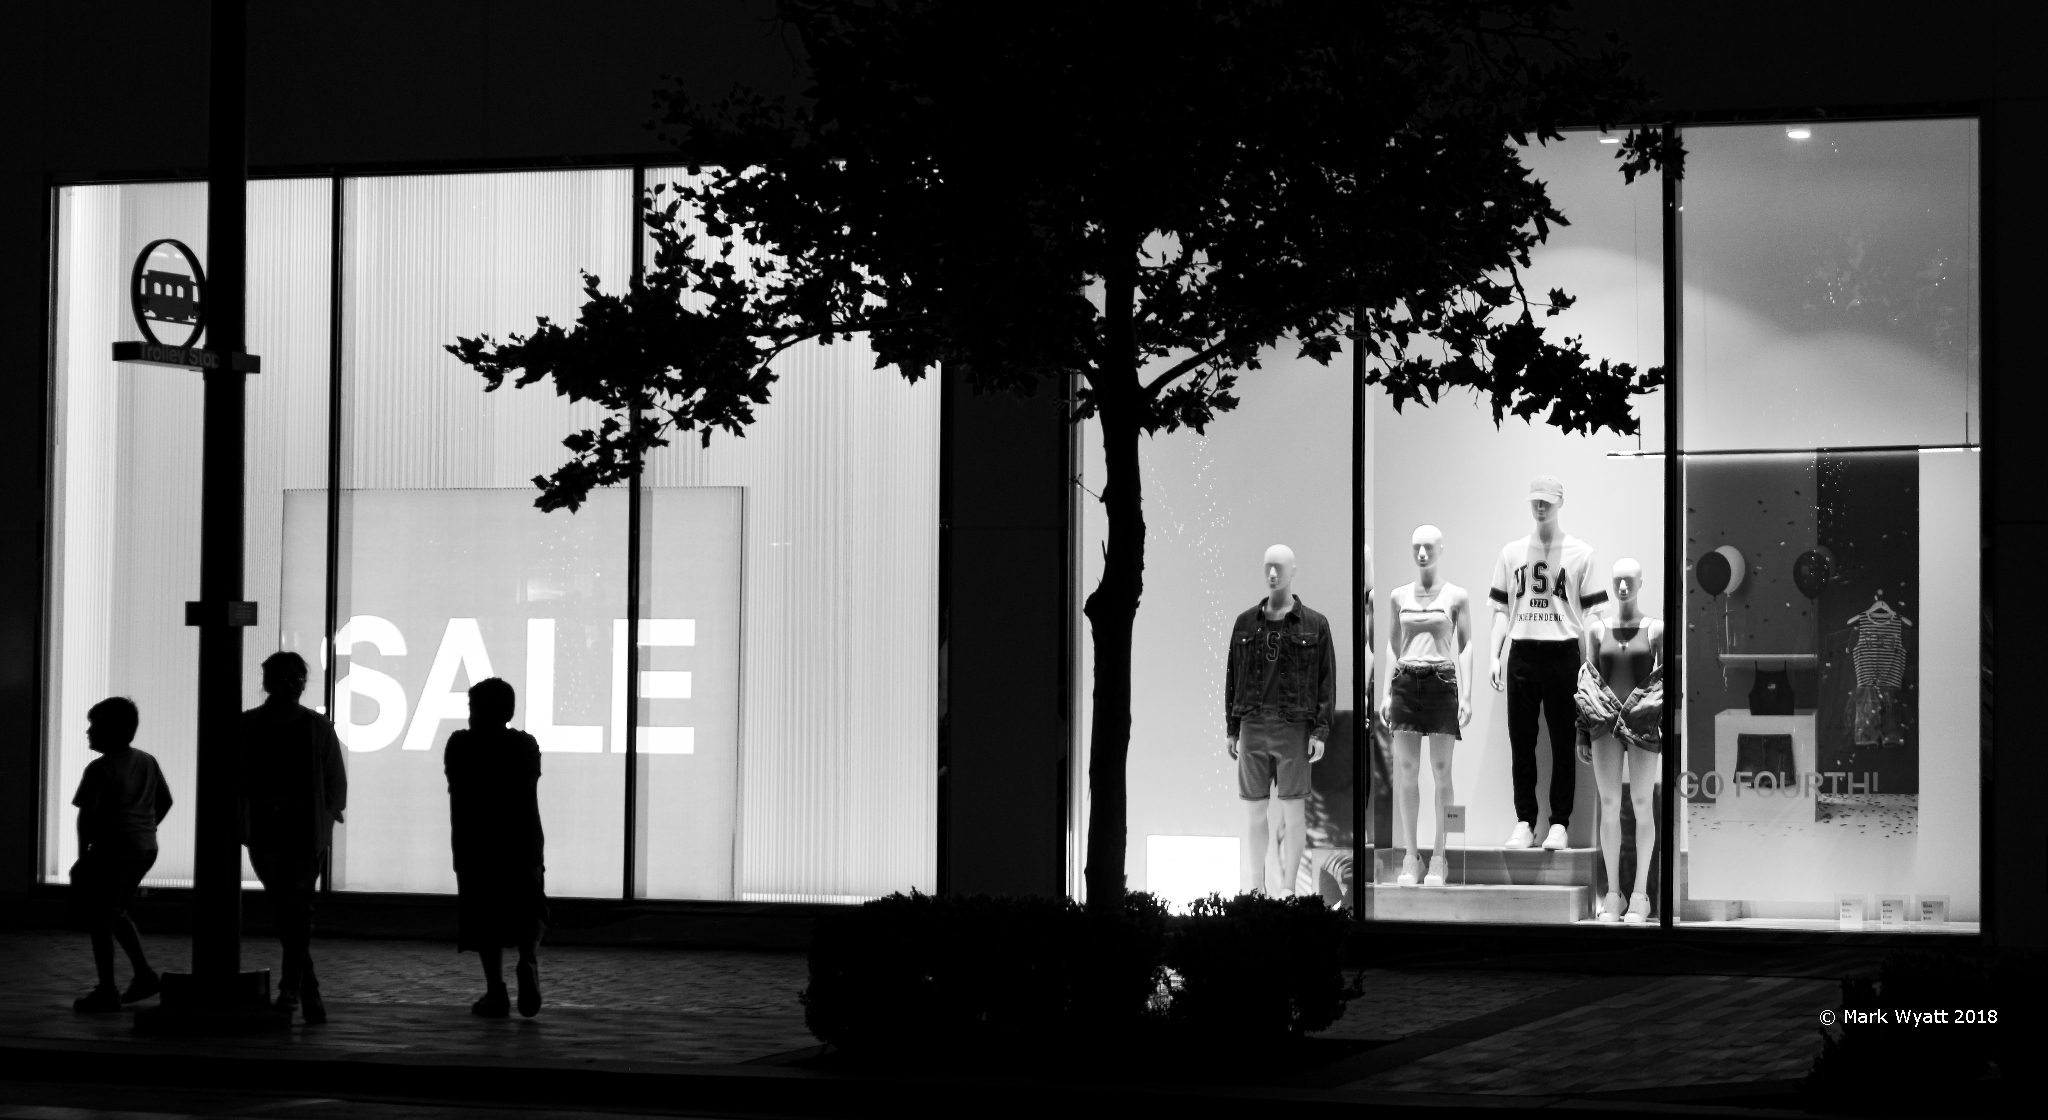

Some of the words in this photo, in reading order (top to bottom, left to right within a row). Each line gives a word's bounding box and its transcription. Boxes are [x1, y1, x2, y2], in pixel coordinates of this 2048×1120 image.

[140, 343, 186, 365] Trolley
[189, 348, 220, 369] Stop
[1514, 560, 1568, 602] USA
[1531, 600, 1547, 608] 1776
[1266, 631, 1280, 661] S
[316, 615, 695, 754] SALE
[1676, 771, 1724, 798] GO
[1735, 771, 1879, 798] FOURTH!
